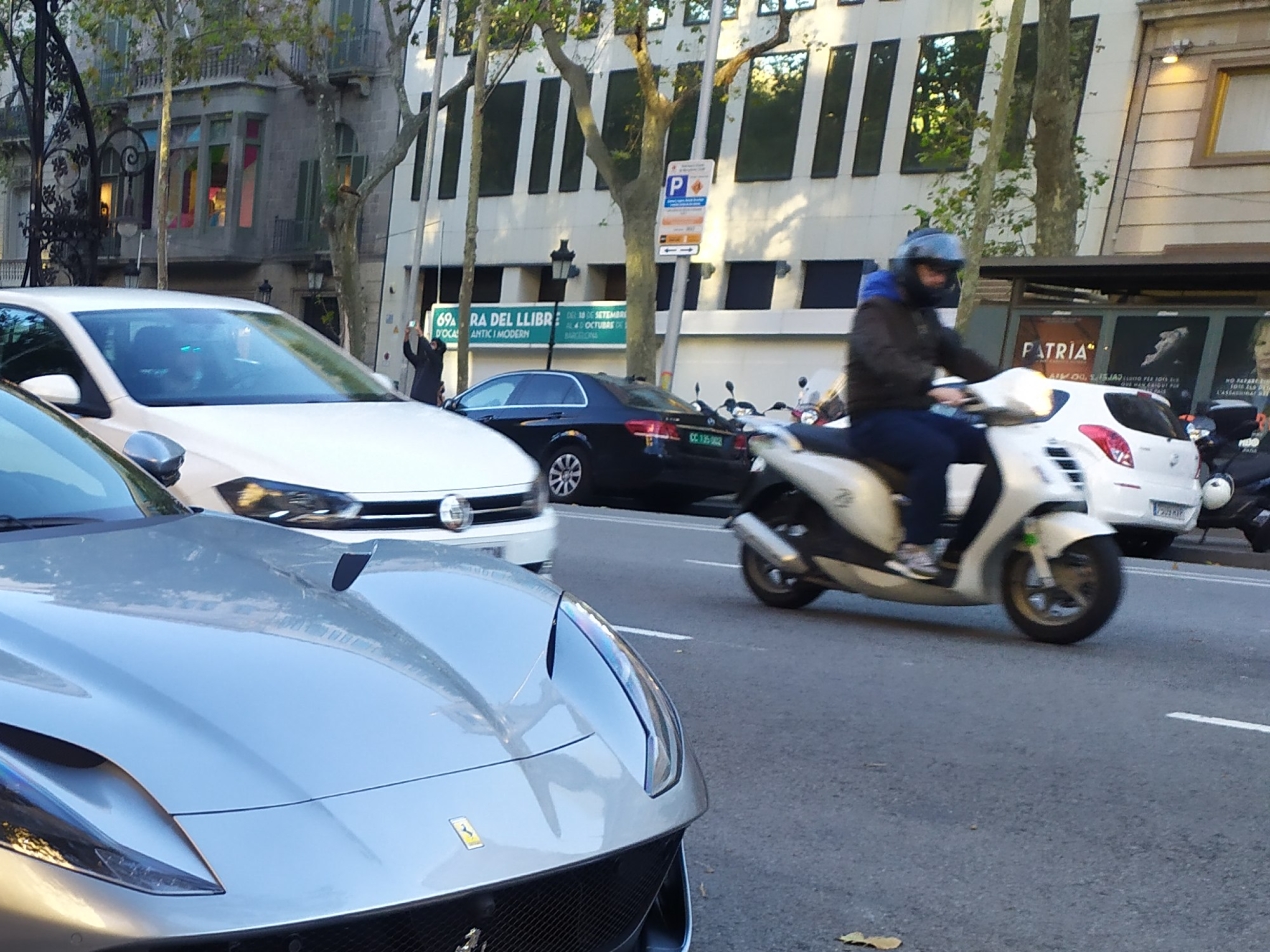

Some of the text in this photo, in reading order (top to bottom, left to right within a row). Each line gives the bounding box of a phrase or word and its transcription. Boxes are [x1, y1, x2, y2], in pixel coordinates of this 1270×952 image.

[670, 177, 683, 195] P
[490, 312, 513, 327] DEL
[516, 311, 560, 327] LLIBRE
[471, 329, 492, 339] ANTIC
[497, 329, 530, 339] MODERN
